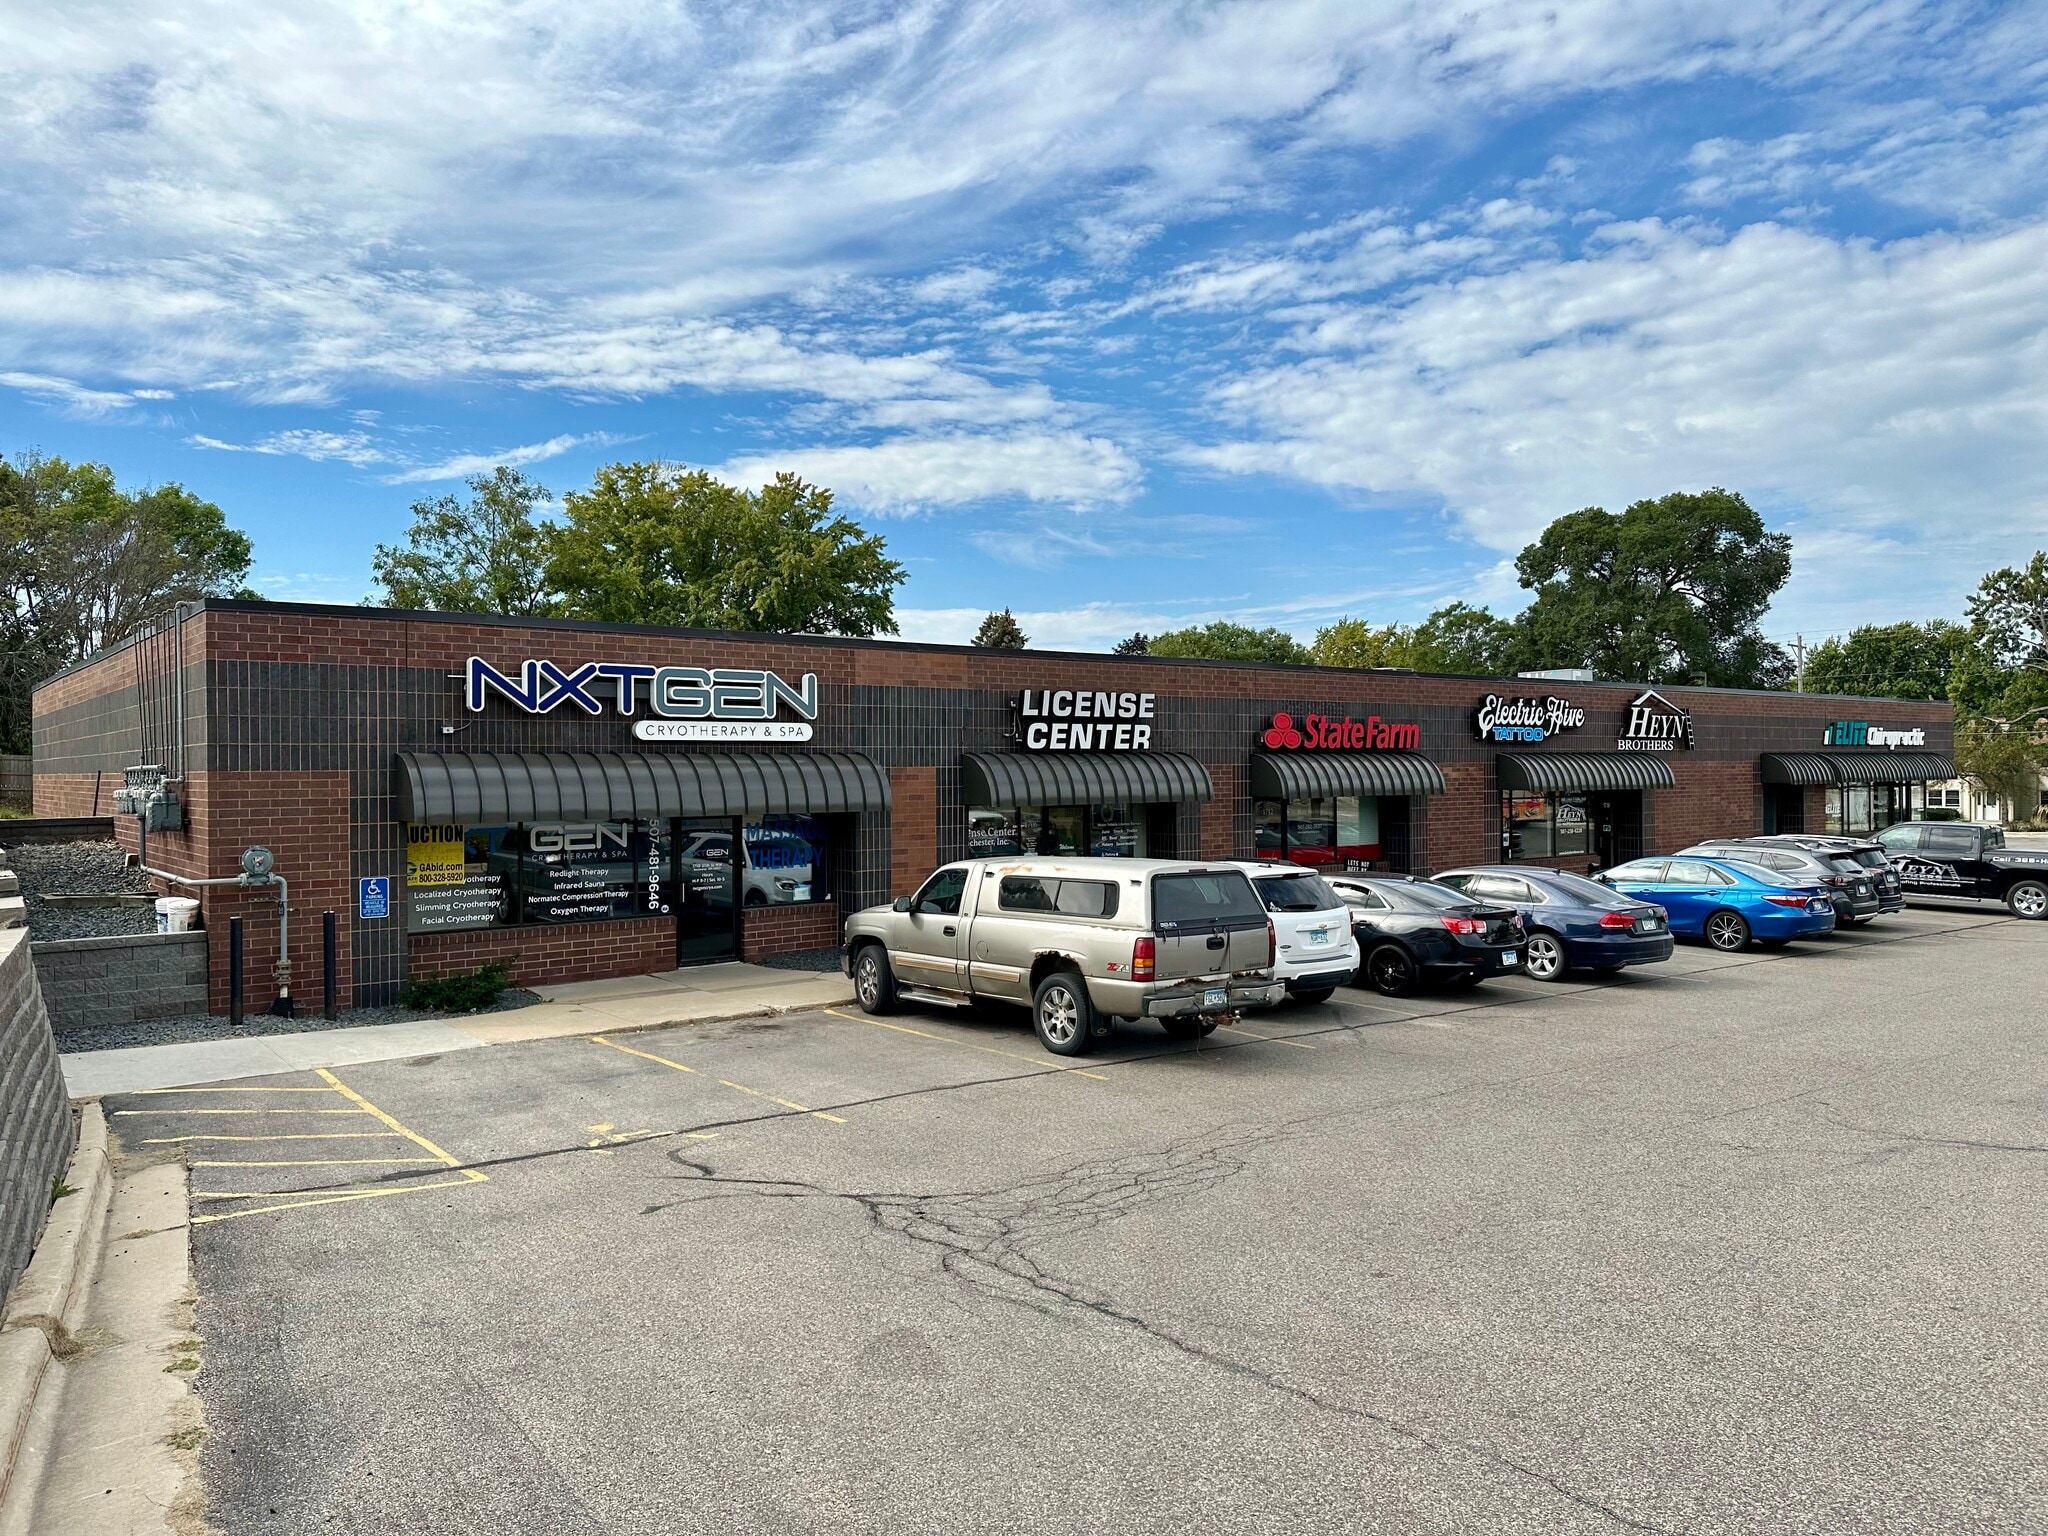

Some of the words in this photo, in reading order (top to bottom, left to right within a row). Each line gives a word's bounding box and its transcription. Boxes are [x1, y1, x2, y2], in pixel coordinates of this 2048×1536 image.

[465, 655, 818, 720] NXTGEN
[1022, 689, 1155, 718] LICENSE
[1478, 694, 1545, 739] Electric
[1544, 696, 1585, 736] Hive
[1626, 707, 1686, 738] HEYN
[645, 723, 757, 737] CRYOTHERAPY
[763, 726, 772, 737] &
[779, 726, 804, 738] SPA
[1027, 722, 1151, 749] CENTER
[1304, 713, 1364, 749] State
[1366, 716, 1420, 749] Farm
[1493, 726, 1544, 741] TATTOO
[1866, 727, 1925, 750] Chiropractic
[1617, 739, 1674, 751] BROTHERS
[968, 837, 995, 846] chester,
[996, 837, 1010, 846] Inc.
[648, 818, 660, 910] 507-481-9646
[750, 847, 824, 870] THERAPY
[419, 863, 463, 872] GAbid.com
[549, 869, 579, 879] Redlight
[580, 868, 609, 877] Therapy
[418, 872, 463, 883] 800-328-5920
[464, 874, 502, 884] yotherapy
[554, 881, 583, 890] Infrared
[584, 880, 605, 888] Sauna
[414, 890, 452, 899] Localized
[453, 888, 502, 897] Cryotherapy
[528, 894, 561, 903] Normatec
[561, 892, 603, 902] Compression
[604, 890, 629, 899] Therapy
[415, 903, 451, 911] Slimming
[452, 900, 501, 910] Cryotherapy
[550, 907, 578, 915] Oxygen
[580, 904, 609, 914] Therapy
[421, 917, 444, 925] Facial
[446, 914, 495, 923] Cryotherapy
[1107, 962, 1130, 972] Z71
